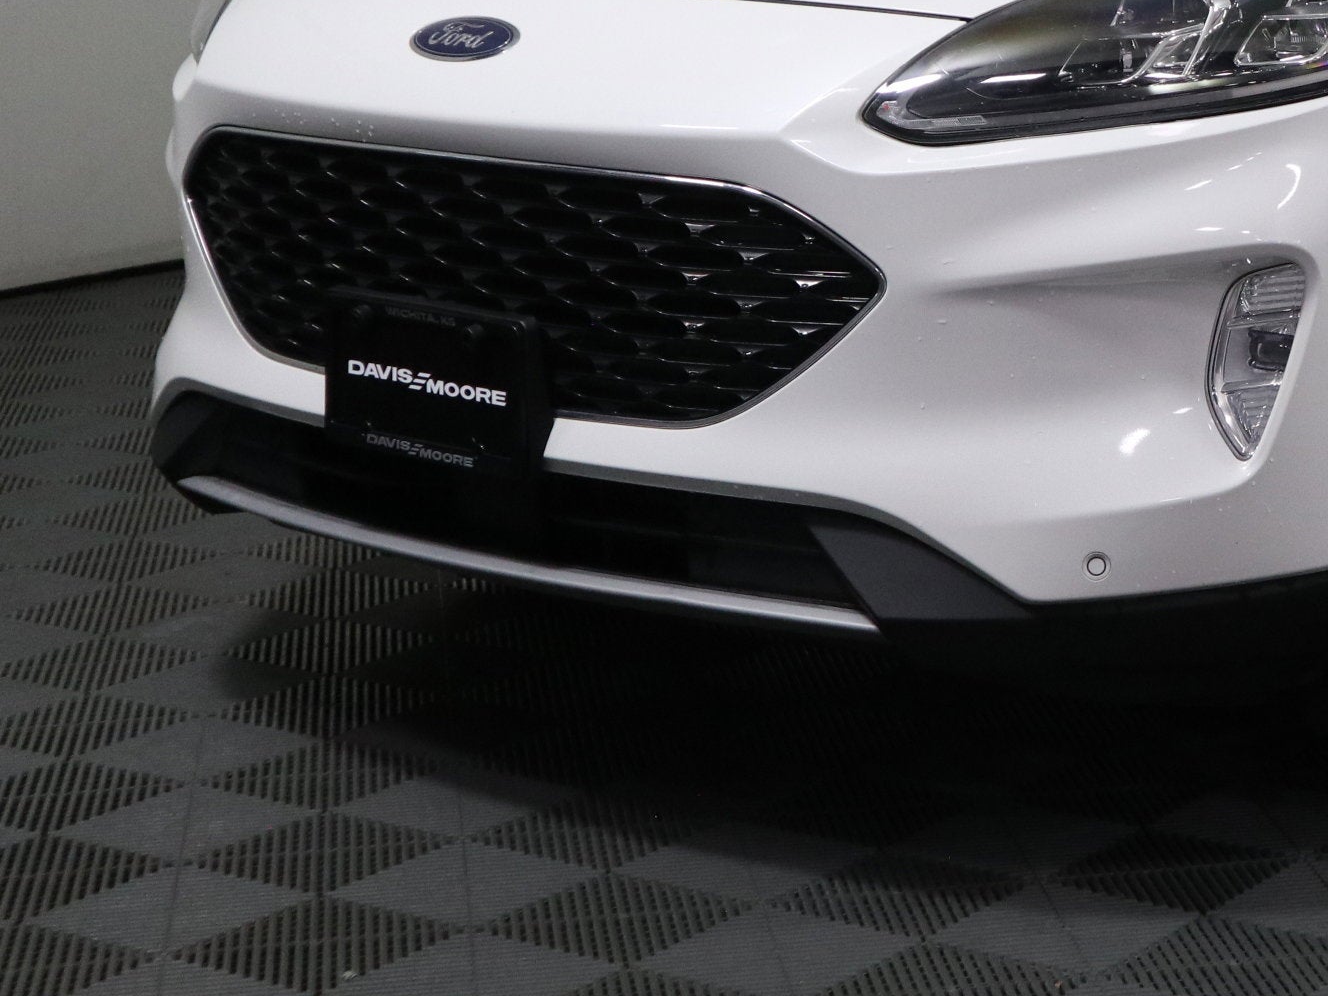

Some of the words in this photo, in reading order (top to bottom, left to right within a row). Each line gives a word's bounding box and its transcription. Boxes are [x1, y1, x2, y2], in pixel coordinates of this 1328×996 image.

[427, 20, 495, 49] Ford
[347, 359, 413, 383] DAVIS
[426, 378, 507, 406] MOORE
[366, 433, 411, 451] DAVIS
[419, 449, 474, 468] MOORE
